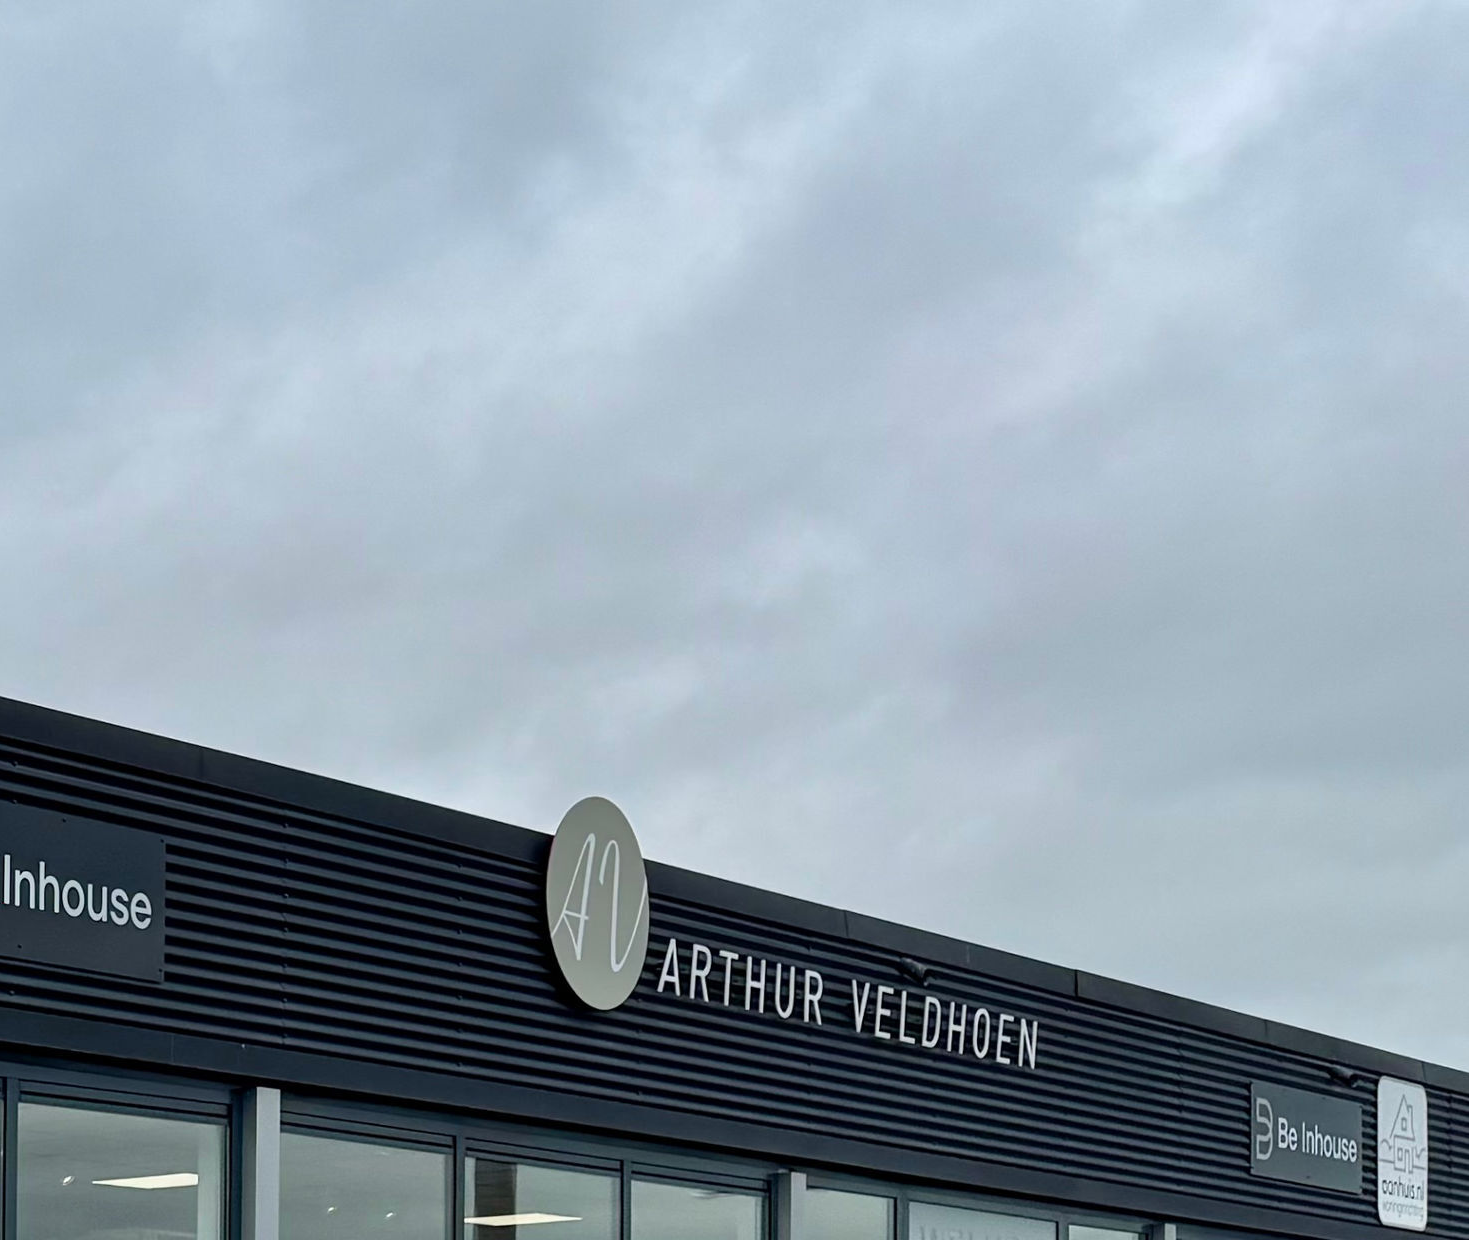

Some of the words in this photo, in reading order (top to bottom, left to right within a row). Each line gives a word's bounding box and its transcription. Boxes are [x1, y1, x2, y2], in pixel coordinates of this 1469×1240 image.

[3, 853, 153, 930] Inhouse
[656, 937, 825, 1027] ARTHUR
[850, 978, 1039, 1070] VELDHOEN
[1277, 1116, 1298, 1151] Be
[1301, 1121, 1358, 1163] Inhouse
